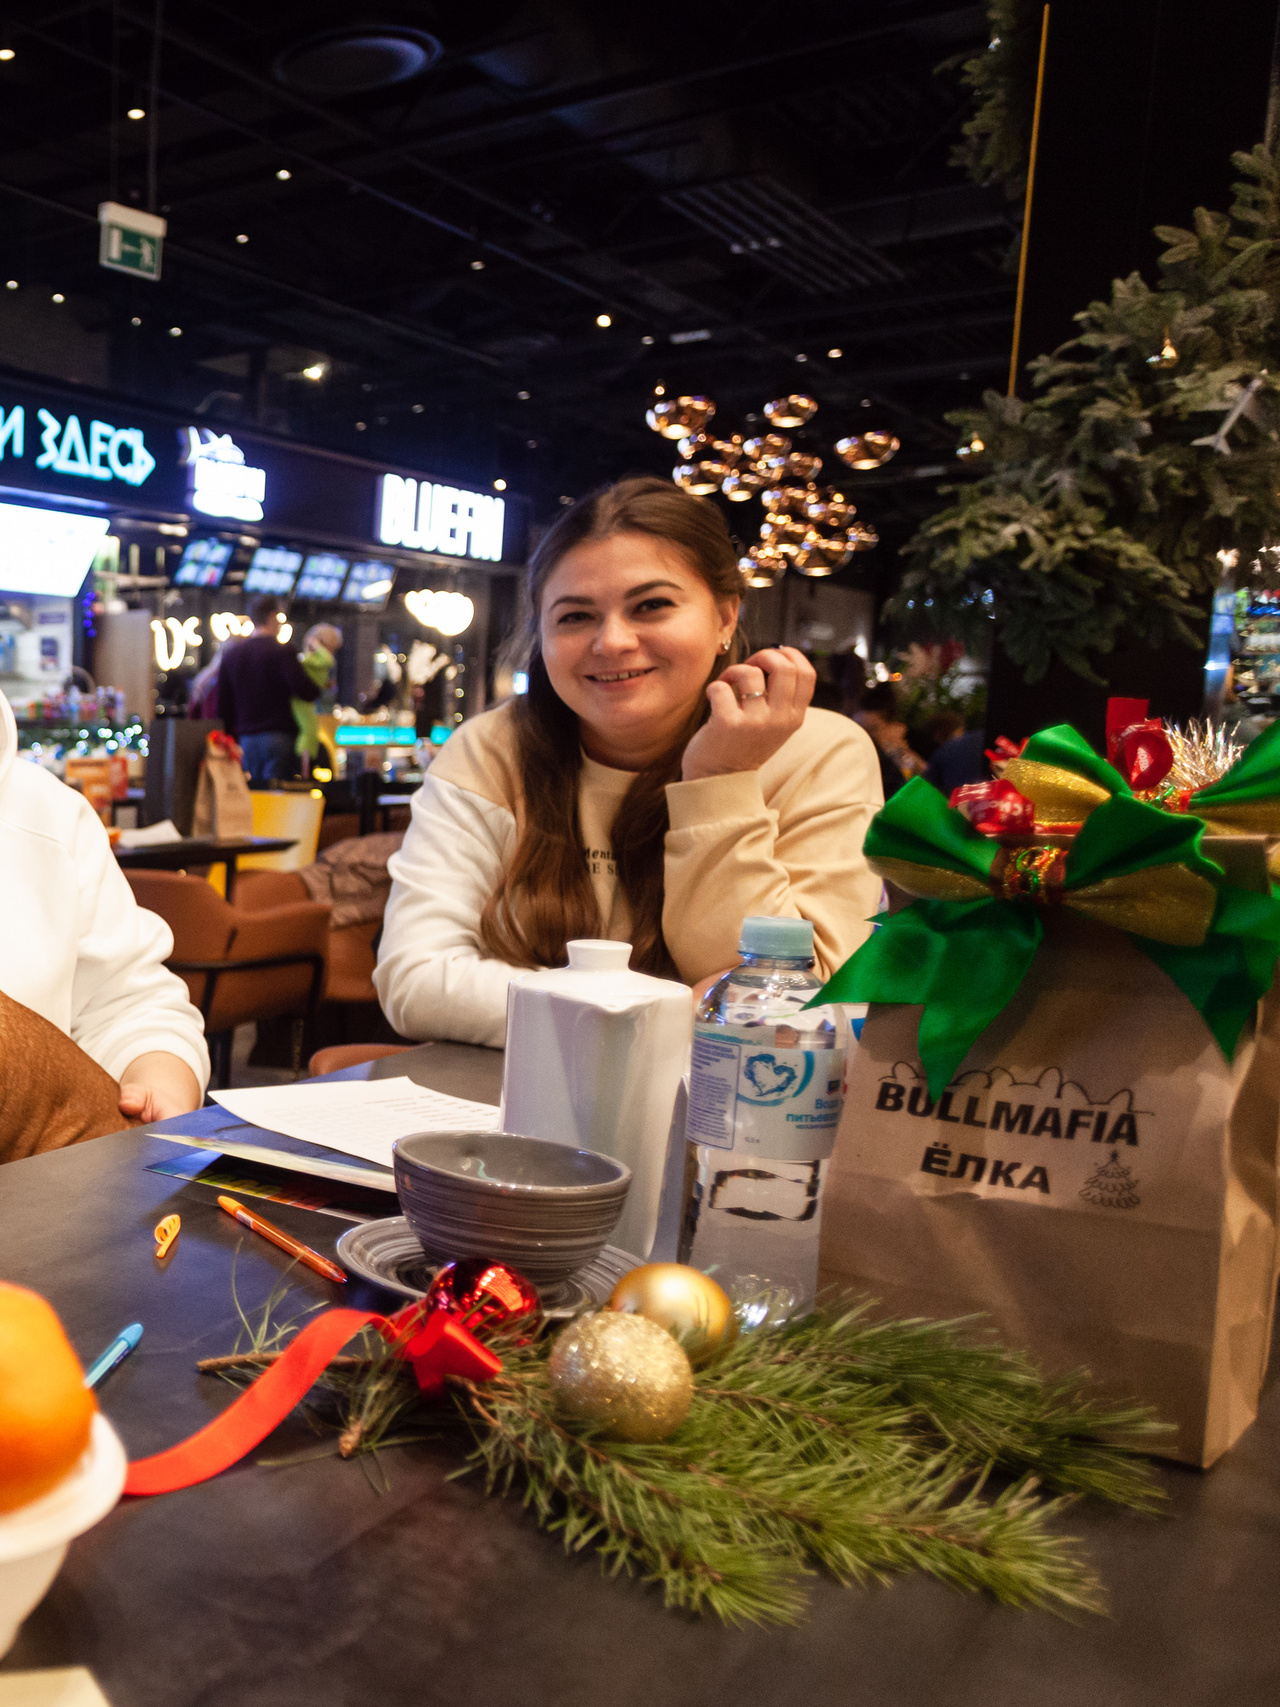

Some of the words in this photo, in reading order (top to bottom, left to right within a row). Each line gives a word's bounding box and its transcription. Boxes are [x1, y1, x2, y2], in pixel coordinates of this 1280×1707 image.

[36, 407, 156, 487] ЗДЕСЬ
[875, 1081, 1139, 1147] BULLMAFIA
[920, 1141, 1051, 1194] ЁЛКА
